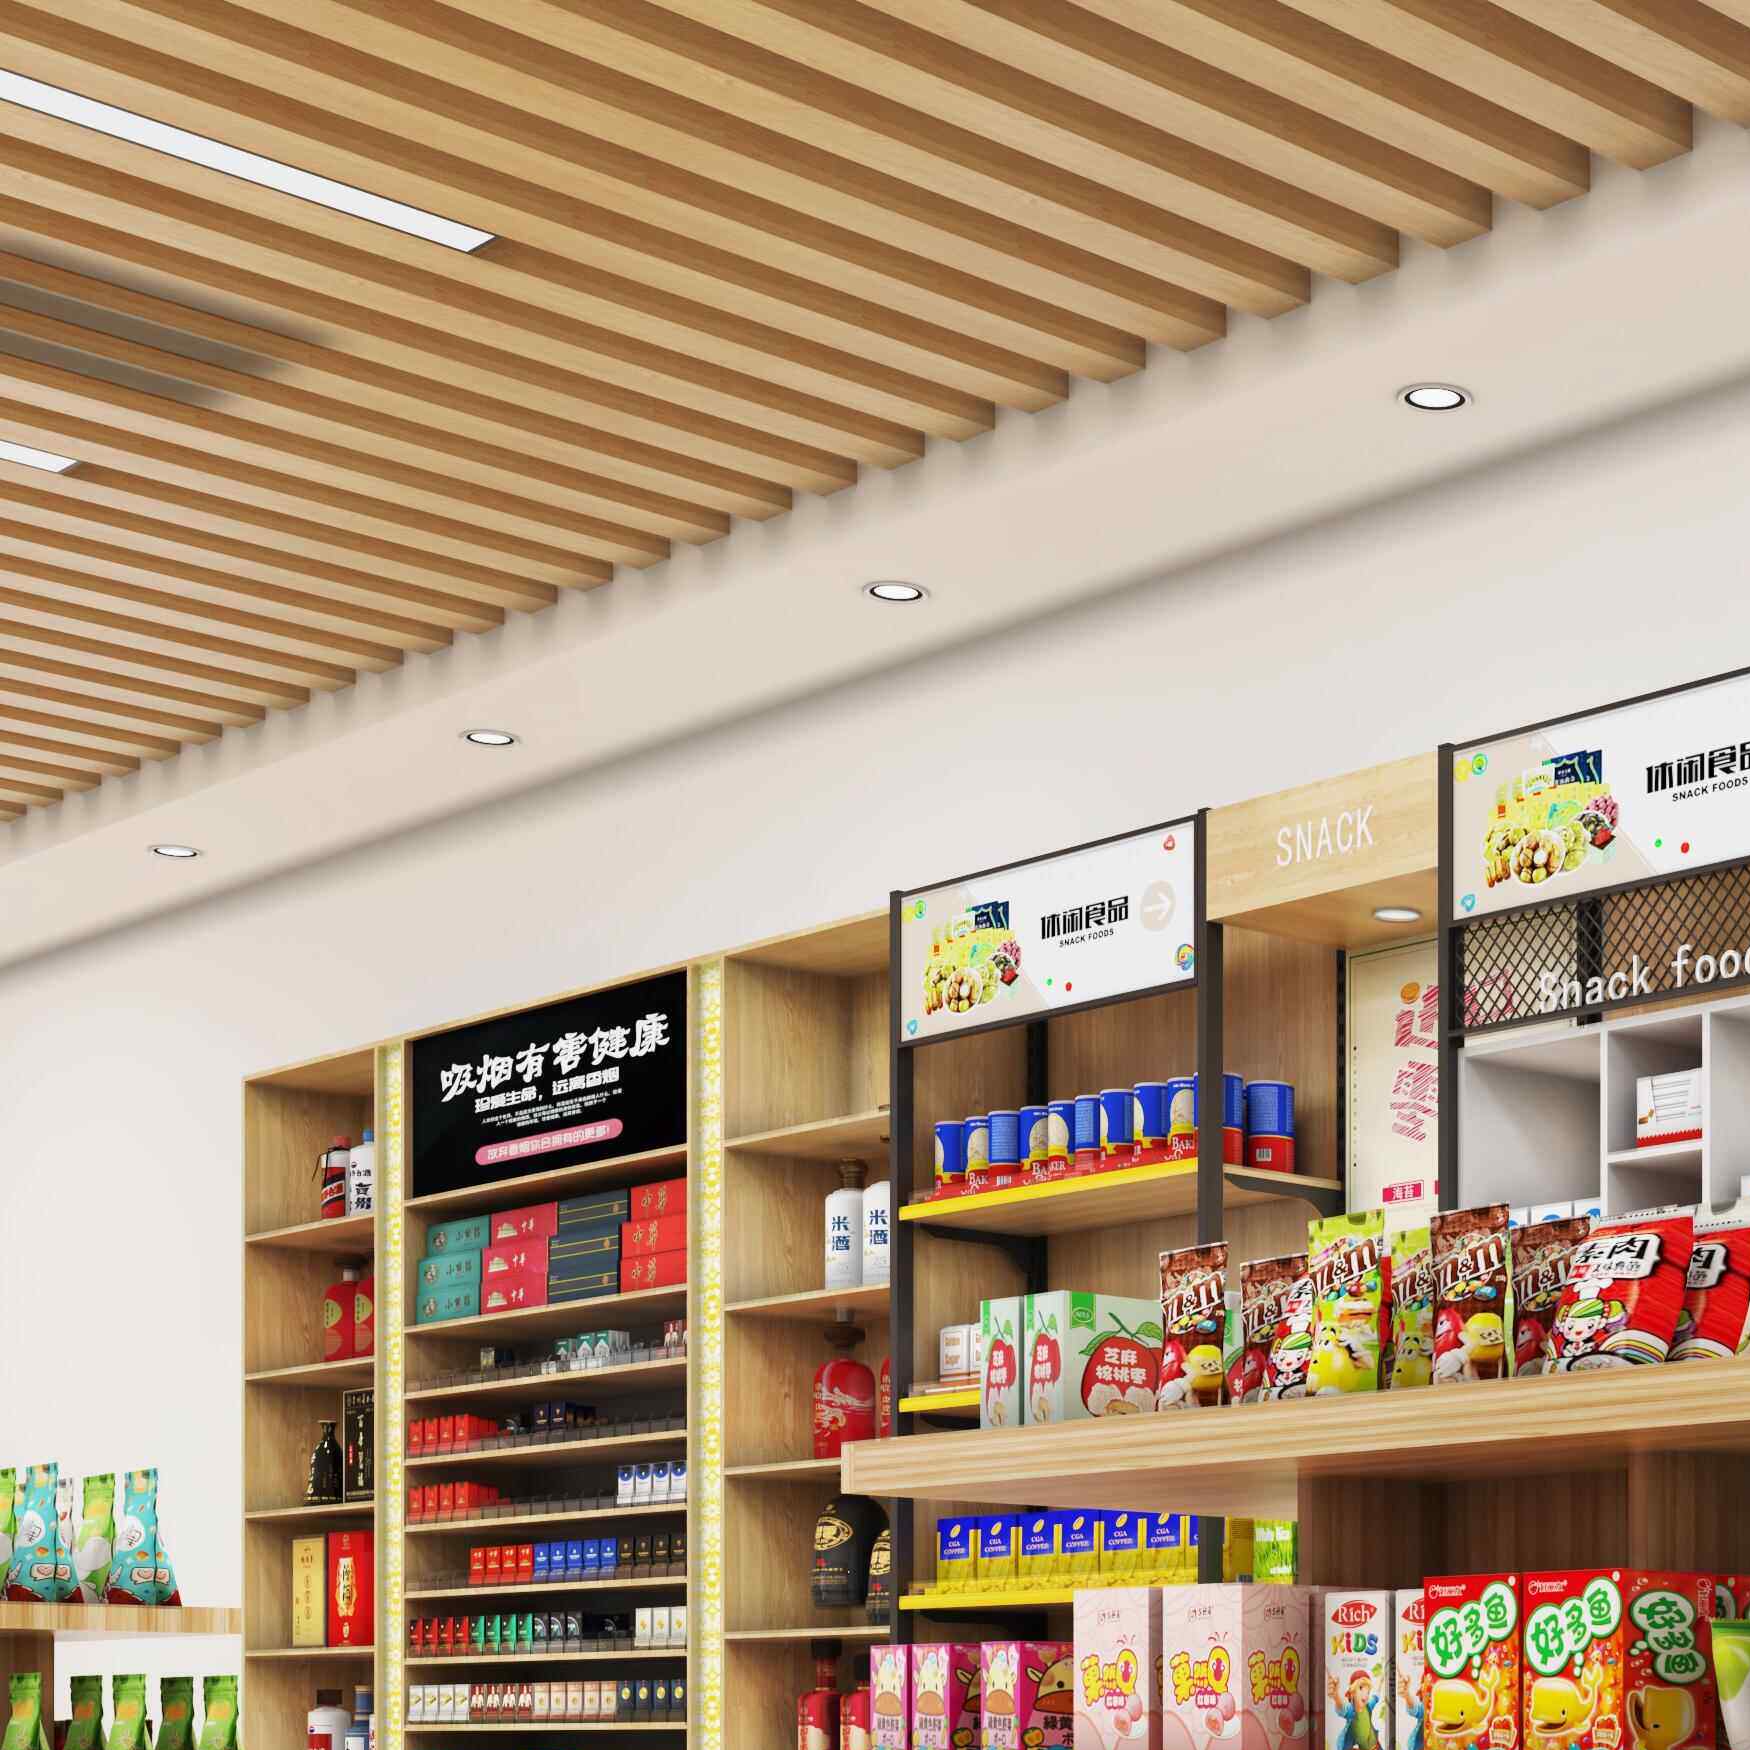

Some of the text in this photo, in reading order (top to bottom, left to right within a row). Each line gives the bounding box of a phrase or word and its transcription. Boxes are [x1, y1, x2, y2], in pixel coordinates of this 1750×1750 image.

[1671, 775, 1749, 803] SNACK FOODS
[1275, 804, 1374, 867] SNACK
[1040, 895, 1129, 941] 休闲食品
[1059, 927, 1115, 948] SNACK FOODS
[1538, 955, 1651, 1015] Snack
[440, 1011, 671, 1103] 吸烟有害健康
[1391, 1185, 1415, 1200] 海苔
[832, 1215, 851, 1252] 米酒
[869, 1208, 889, 1246] 米酒
[1103, 1347, 1138, 1366] 芝麻
[1337, 1605, 1371, 1623] Rich
[1430, 1591, 1510, 1668] 好多鱼
[1530, 1586, 1613, 1666] 好多鱼
